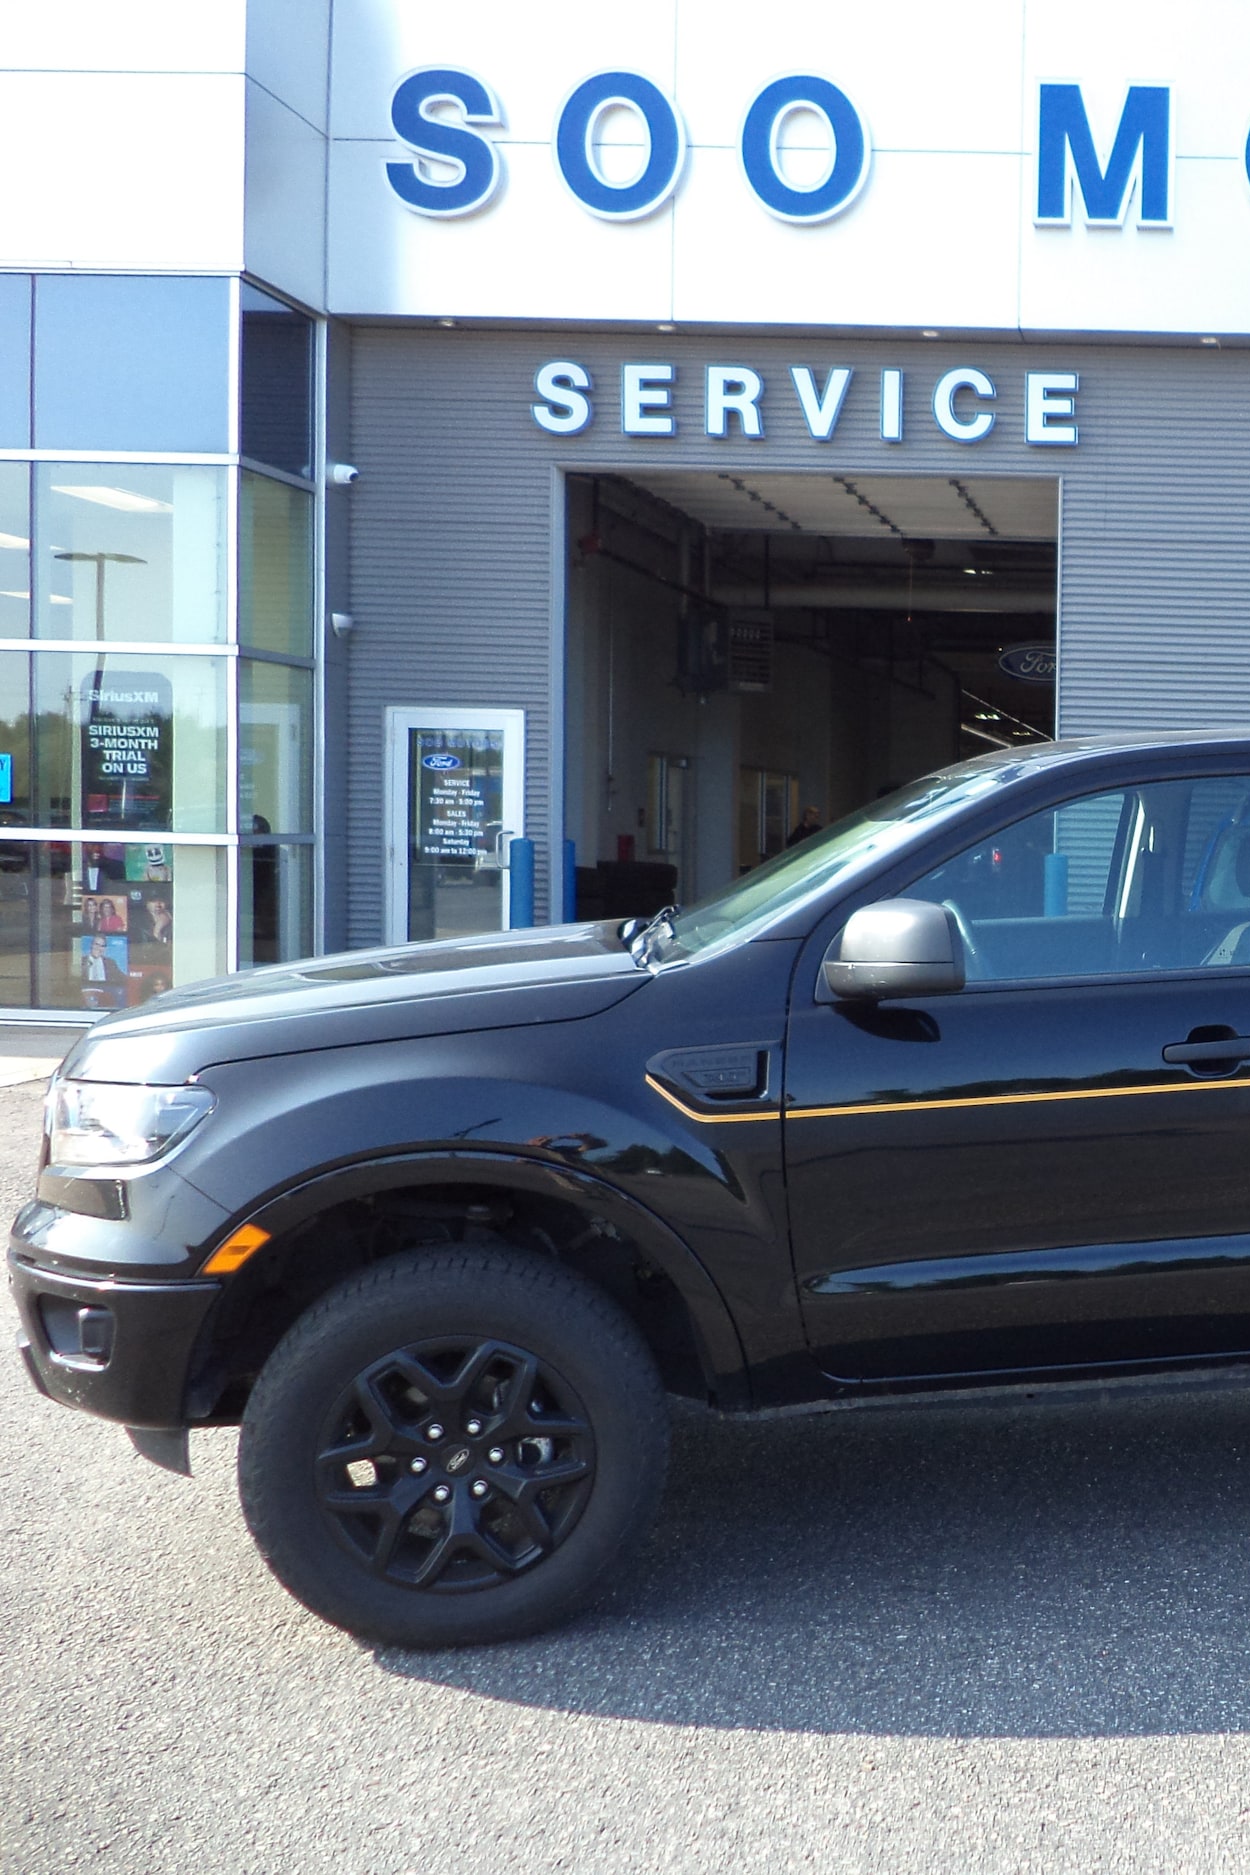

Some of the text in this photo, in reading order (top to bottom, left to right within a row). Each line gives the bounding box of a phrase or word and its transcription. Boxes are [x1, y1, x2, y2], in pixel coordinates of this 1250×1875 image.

[382, 65, 872, 224] SOO
[531, 360, 1082, 448] SERVICE
[88, 724, 159, 738] SIRIUSXM
[90, 737, 158, 750] 3-MONTH
[102, 750, 146, 761] TRIAL
[102, 762, 147, 774] ON US
[433, 788, 457, 796] Monday
[462, 789, 480, 797] Friday
[433, 819, 457, 827] Monday
[462, 820, 480, 828] Friday
[443, 838, 470, 846] Saturday
